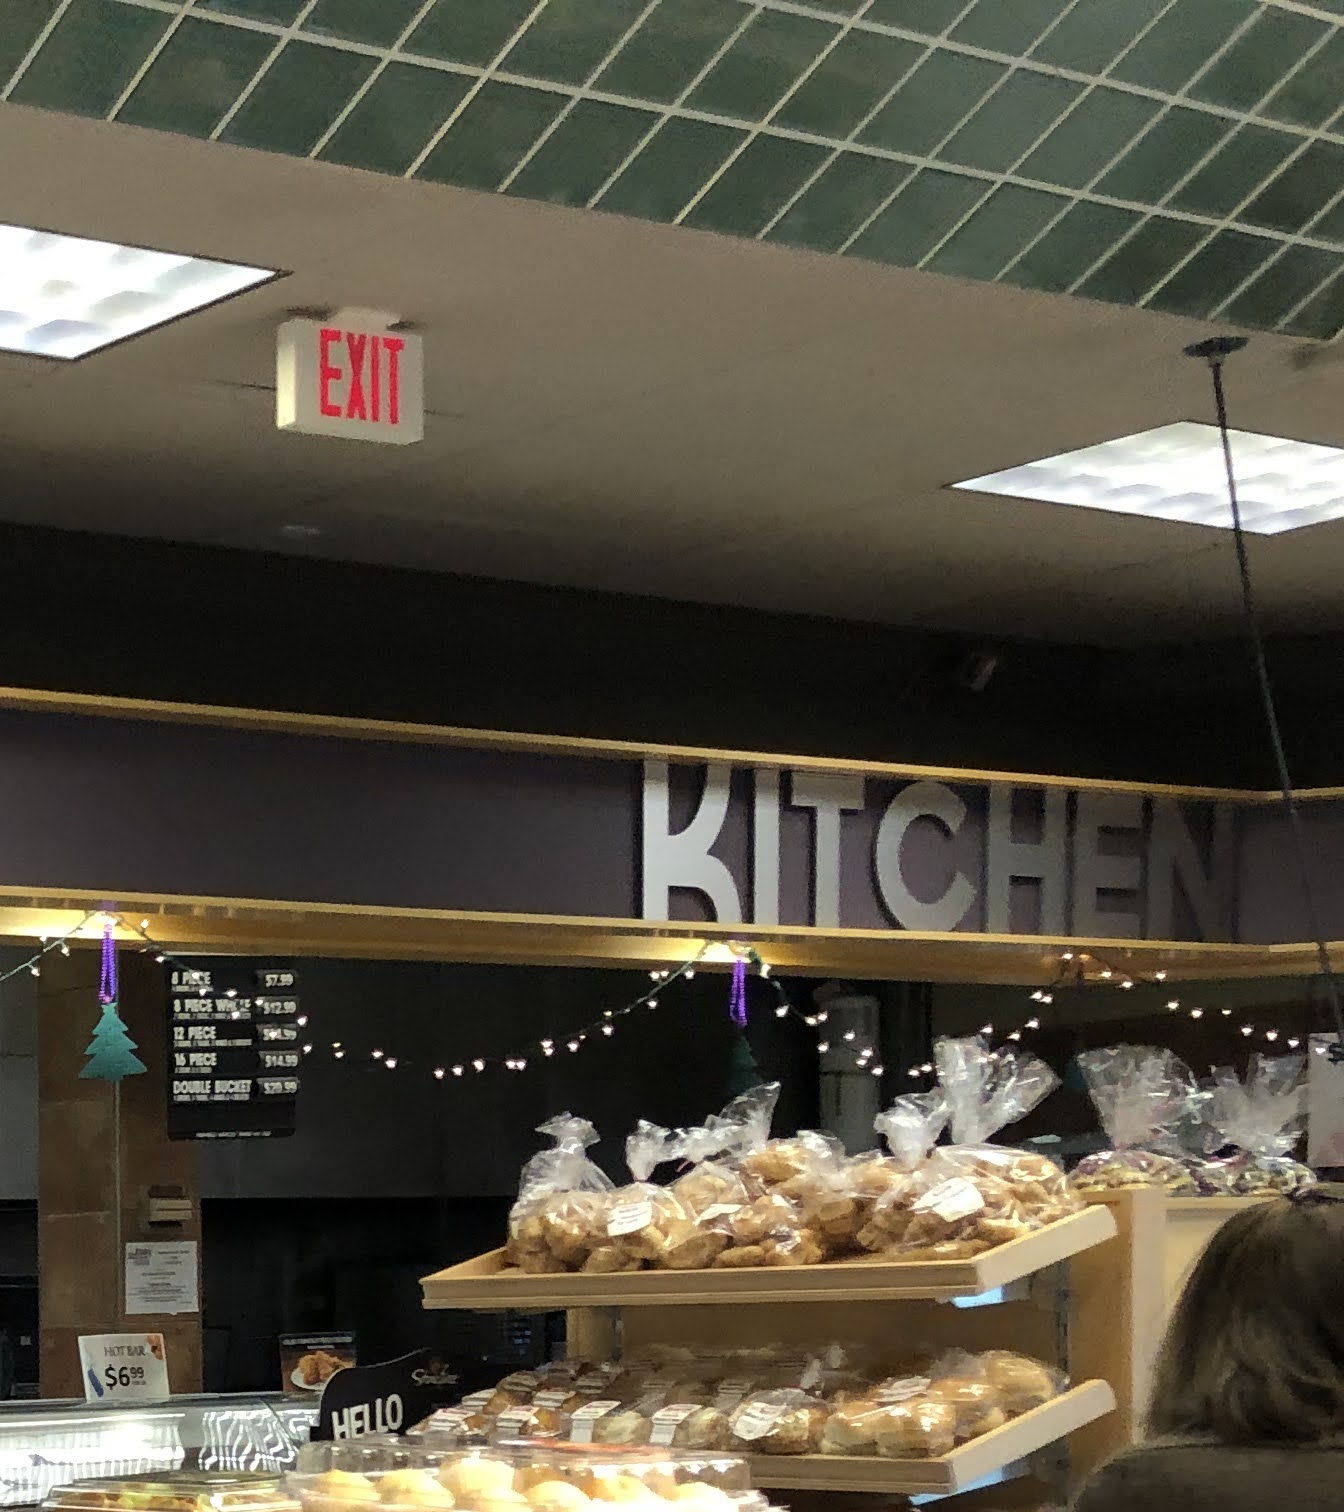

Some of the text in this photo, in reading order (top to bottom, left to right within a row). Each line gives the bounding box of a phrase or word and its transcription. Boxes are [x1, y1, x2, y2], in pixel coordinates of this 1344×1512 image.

[320, 328, 404, 425] EXIT
[642, 757, 1236, 944] KITCHEN
[188, 1026, 217, 1039] PIECE
[189, 1053, 217, 1066] PIECE
[173, 1080, 212, 1093] DOUBLE
[215, 1080, 252, 1093] BUCKET
[104, 1345, 146, 1357] HOT BAR
[330, 1393, 404, 1441] HELLO
